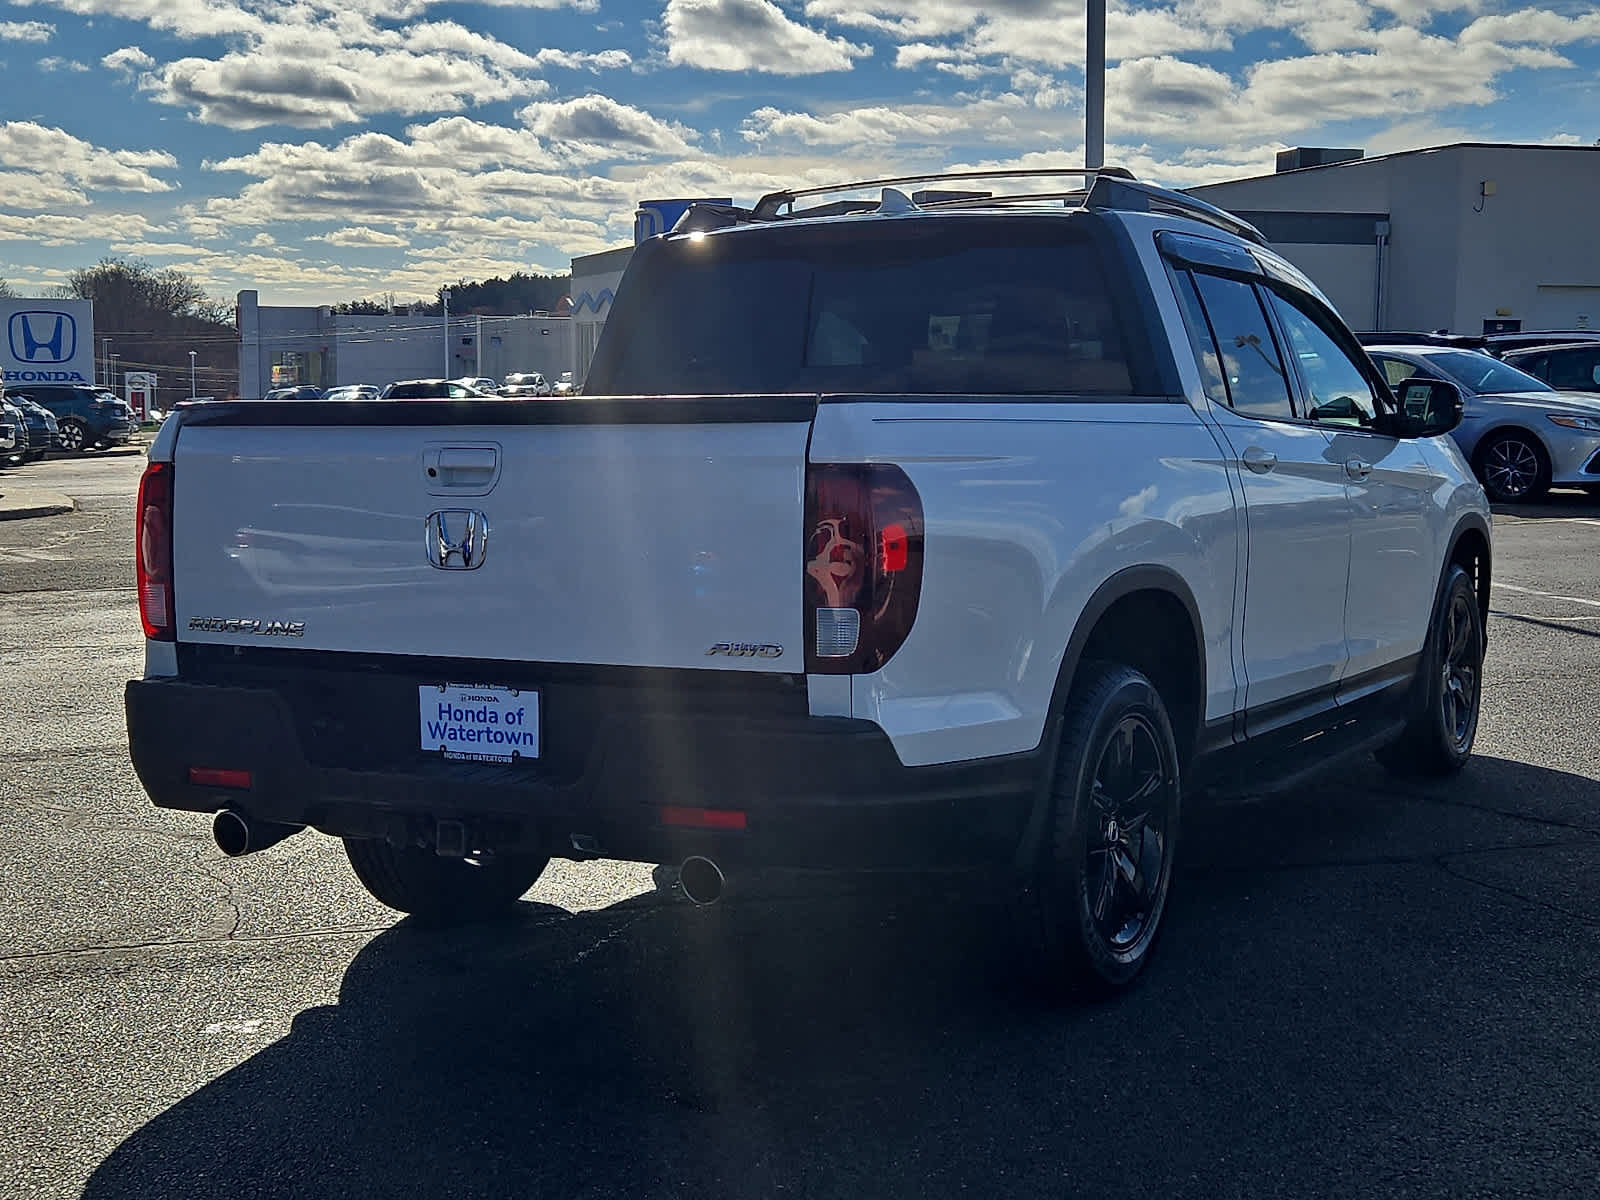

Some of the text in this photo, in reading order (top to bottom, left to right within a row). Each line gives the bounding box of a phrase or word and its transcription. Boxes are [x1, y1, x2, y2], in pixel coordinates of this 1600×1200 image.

[3, 371, 87, 382] HONDA
[188, 616, 305, 637] RIDGELINE
[704, 642, 784, 658] AWD
[471, 695, 500, 703] HONDA
[438, 703, 525, 725] Honda of
[427, 721, 534, 746] Watertown
